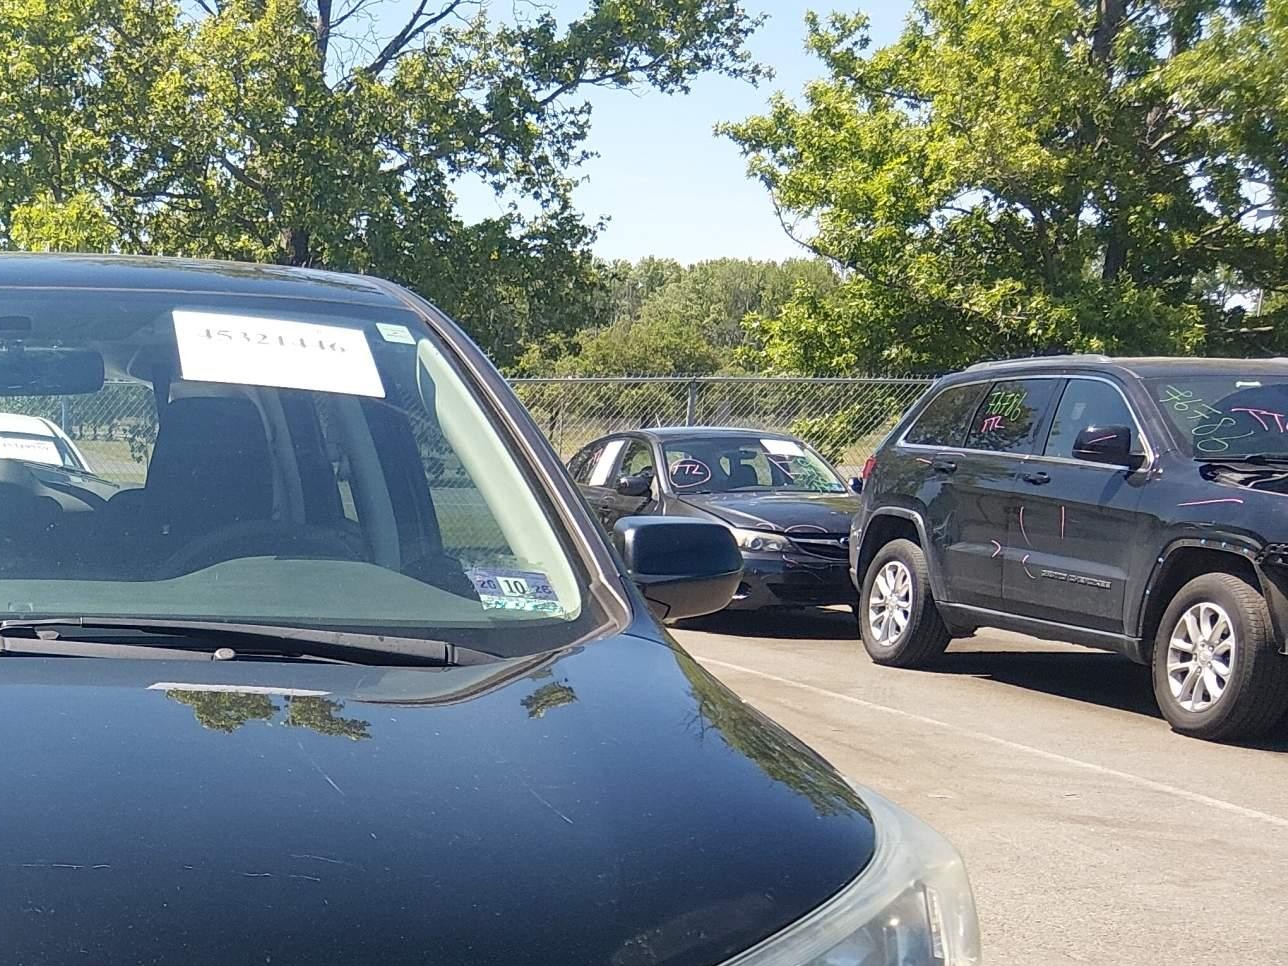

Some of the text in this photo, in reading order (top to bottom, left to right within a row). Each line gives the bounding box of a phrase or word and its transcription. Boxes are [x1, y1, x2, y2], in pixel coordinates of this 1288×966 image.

[1230, 407, 1288, 433] TT
[672, 463, 705, 476] TTL
[503, 580, 527, 594] 10
